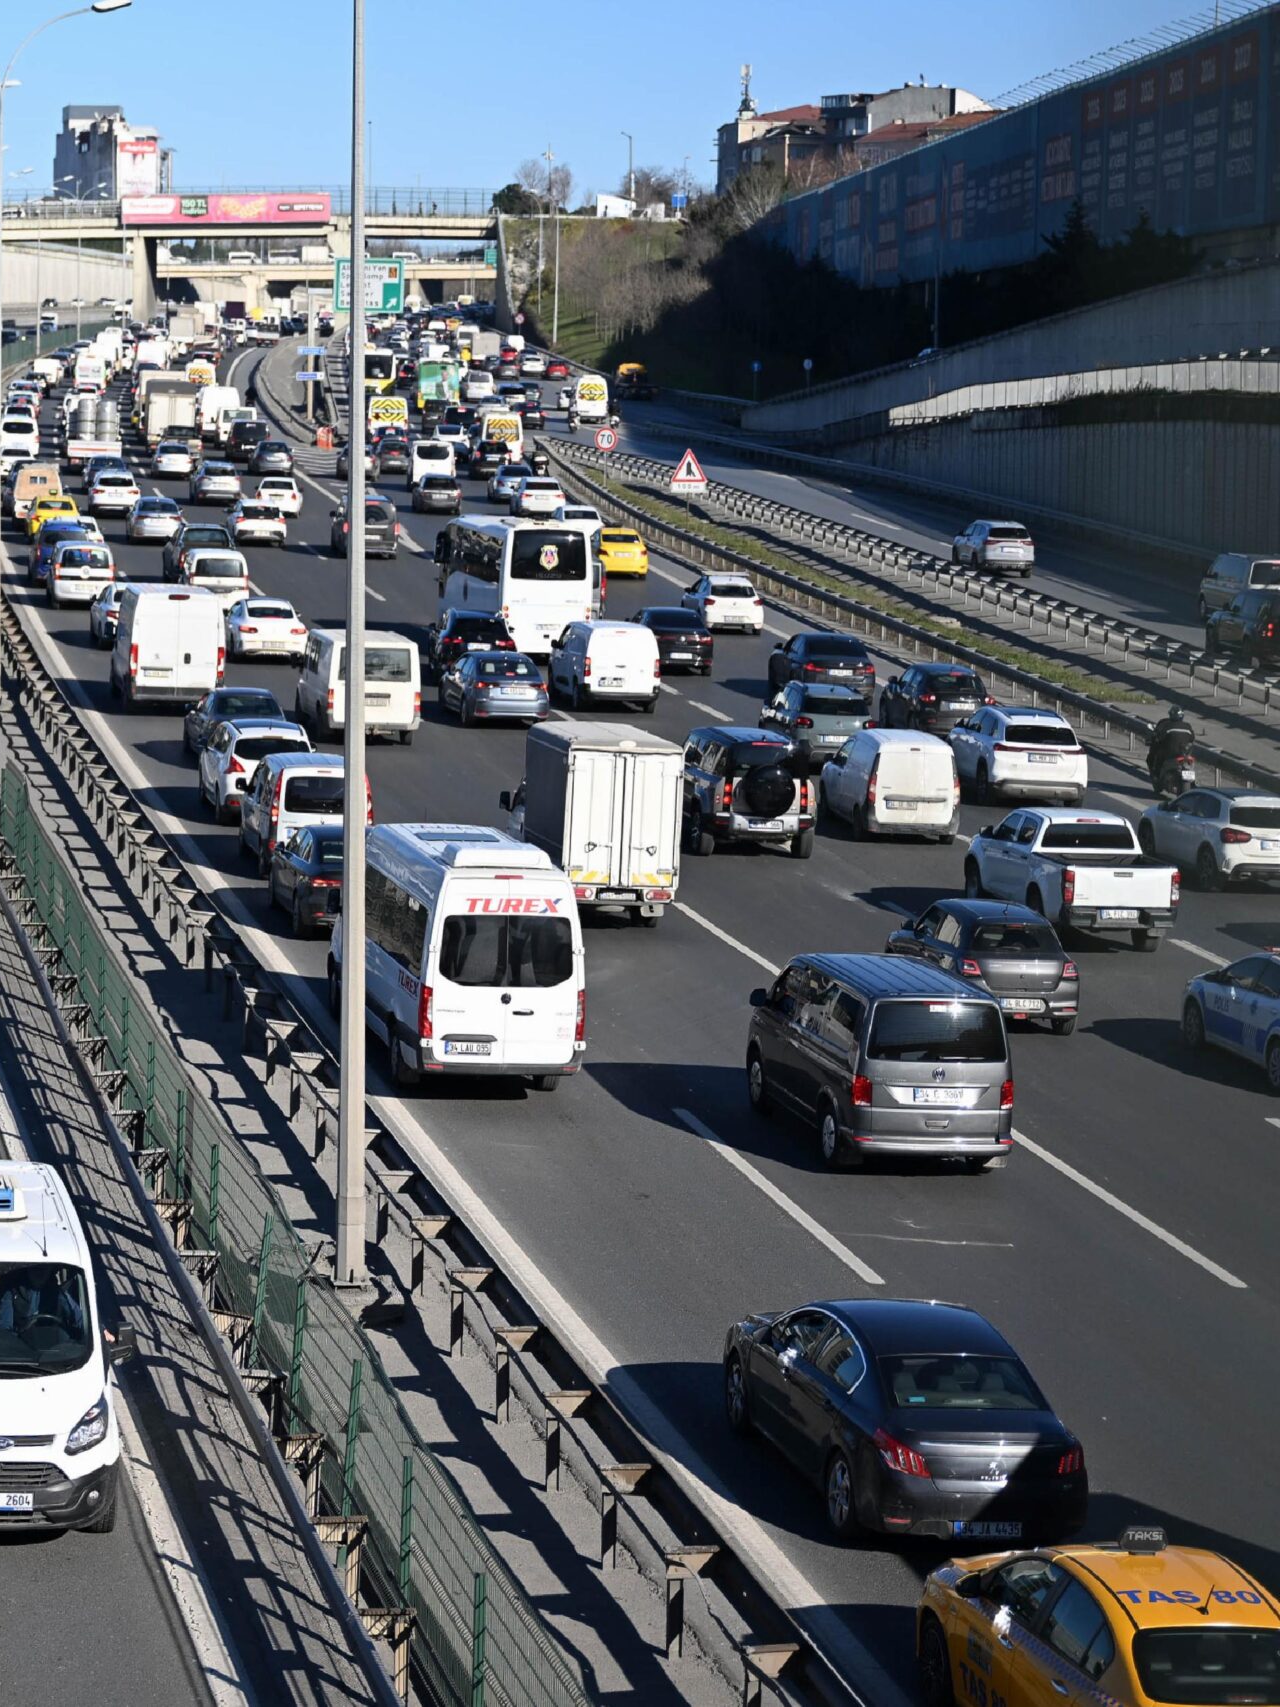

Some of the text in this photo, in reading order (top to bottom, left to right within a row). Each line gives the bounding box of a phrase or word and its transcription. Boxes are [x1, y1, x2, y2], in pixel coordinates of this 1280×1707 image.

[181, 199, 207, 208] 150 TL
[600, 434, 613, 444] 70
[464, 897, 562, 915] TUREX
[398, 969, 419, 997] TUREX
[1028, 999, 1040, 1008] 712
[450, 1043, 489, 1053] 34 LAU 095
[920, 1089, 929, 1098] 34
[6, 1495, 31, 1506] 2604
[961, 1522, 973, 1536] 34
[995, 1522, 1021, 1536] 4435
[1116, 1590, 1263, 1605] TAS 80
[959, 1659, 989, 1707] TAS
